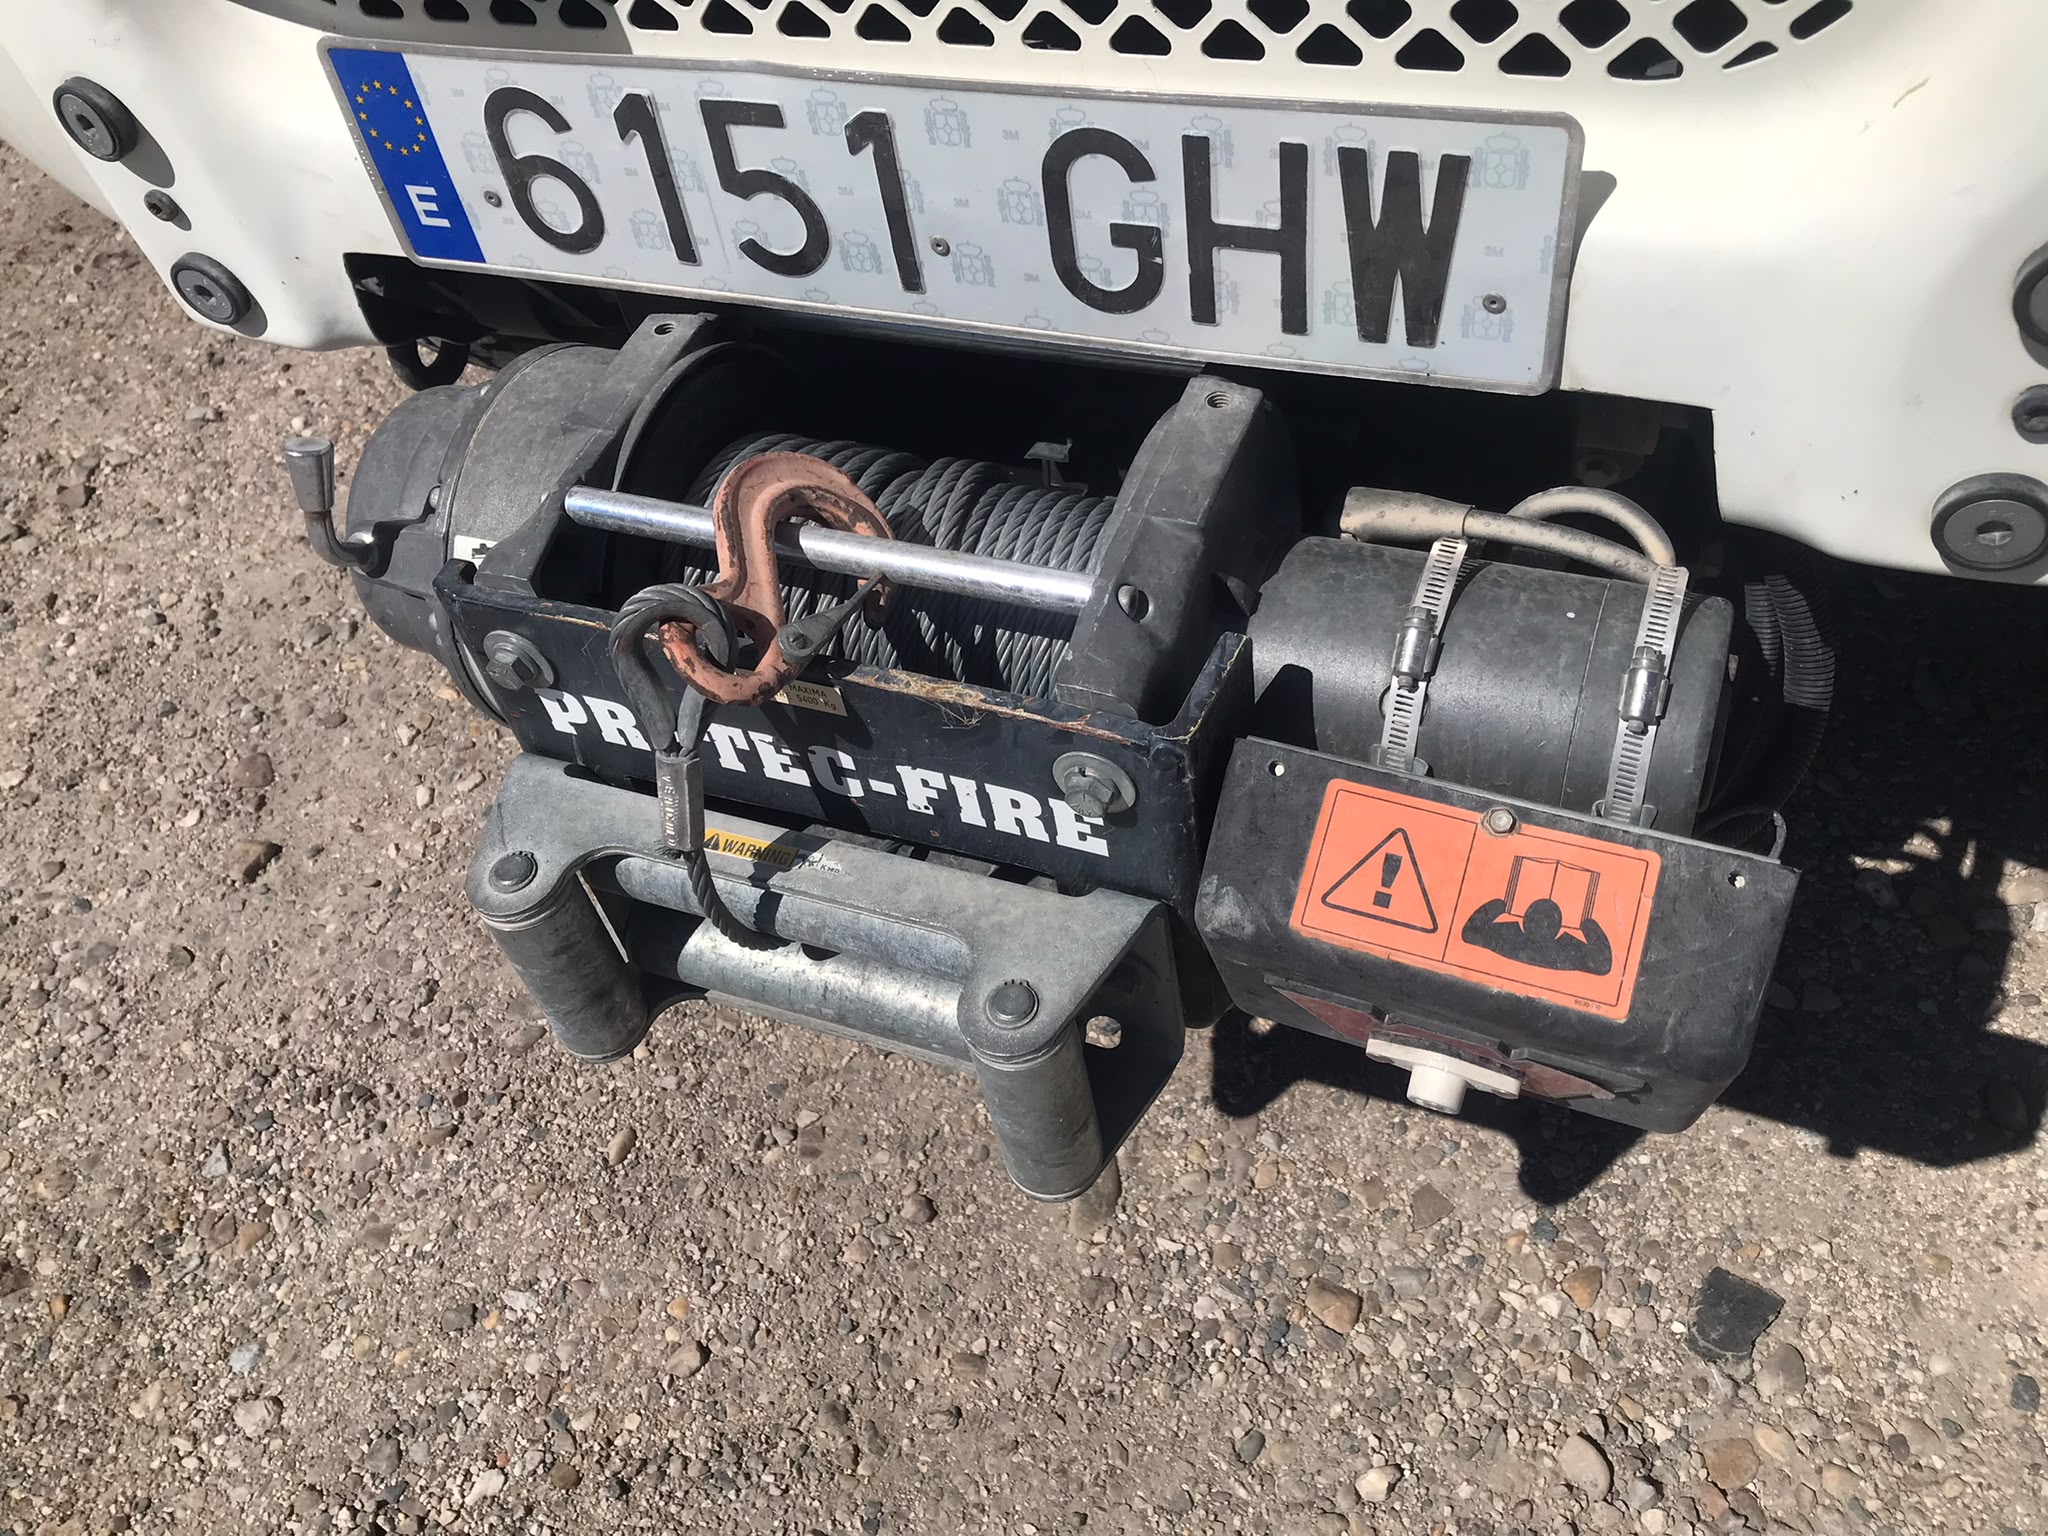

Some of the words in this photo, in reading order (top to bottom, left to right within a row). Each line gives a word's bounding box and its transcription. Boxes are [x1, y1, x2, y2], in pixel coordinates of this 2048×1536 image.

[404, 184, 452, 229] E
[483, 85, 926, 294] 6151
[1041, 126, 1471, 349] GHW
[788, 683, 828, 698] MAXIMA
[796, 694, 819, 706] 5400
[824, 701, 837, 711] Kg
[534, 687, 1110, 858] PRTEC-FIRE
[722, 838, 792, 866] WARNING
